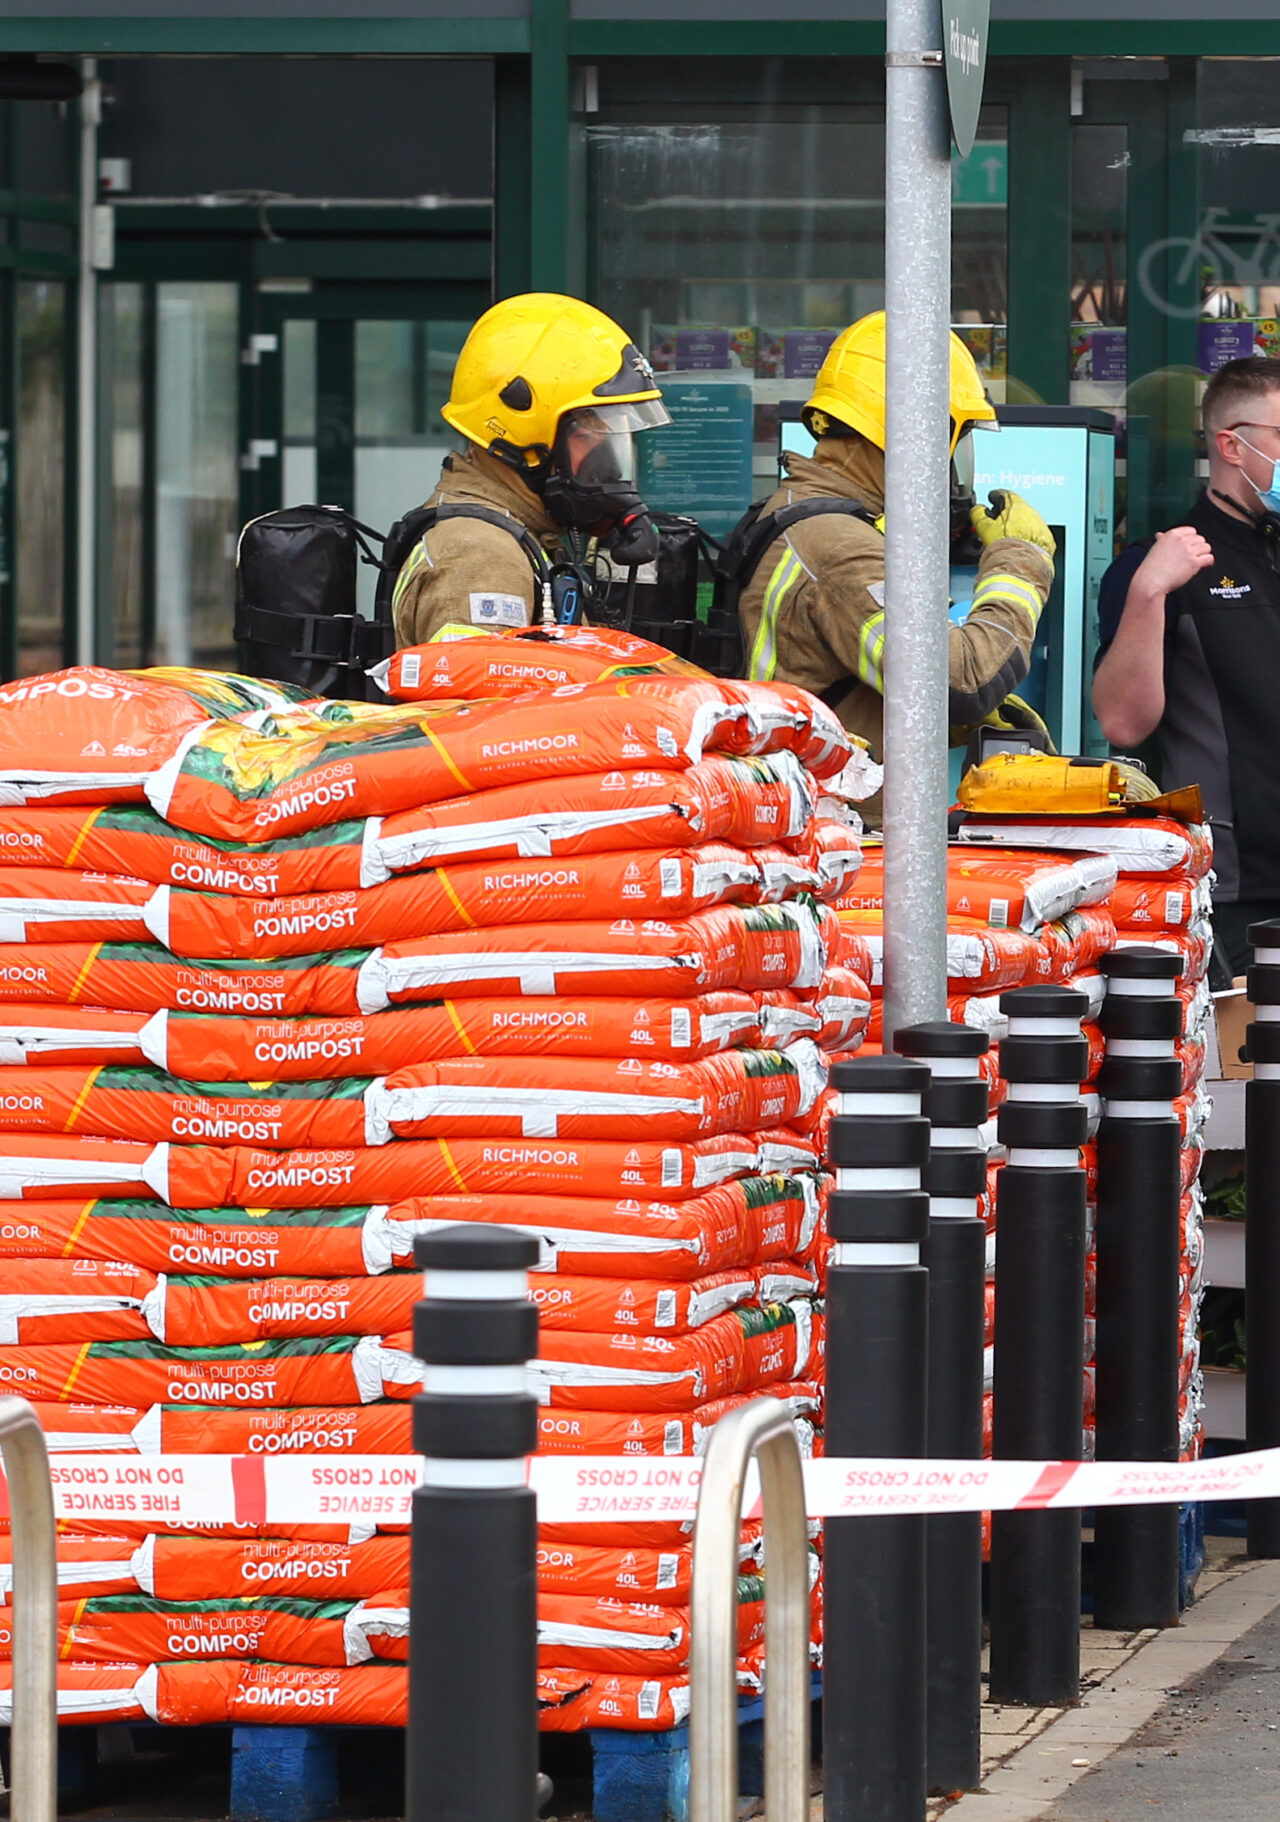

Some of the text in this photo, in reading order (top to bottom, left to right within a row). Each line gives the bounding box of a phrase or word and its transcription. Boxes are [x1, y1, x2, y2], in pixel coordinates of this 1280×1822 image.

[1000, 470, 1065, 489] Hygiene
[432, 674, 452, 684] 40L
[488, 663, 568, 683] RICHMOOR
[482, 734, 579, 758] RICHMOOR
[622, 743, 646, 754] 40L
[254, 778, 358, 827] COMPOST
[172, 844, 279, 872] multi-purpose
[170, 862, 280, 894] COMPOST
[484, 870, 580, 890] RICHMOOR
[621, 884, 642, 895] 40L
[253, 890, 357, 915] multi-purpose
[836, 897, 883, 909] RICHM
[253, 907, 359, 938] COMPOST
[176, 969, 285, 992] multi-purpose
[175, 988, 286, 1011] COMPOST
[492, 1011, 588, 1027] RICHMOOR
[256, 1018, 364, 1041] multi-purpose
[629, 1030, 653, 1041] 40L
[254, 1037, 366, 1062] COMPOST
[172, 1097, 283, 1119] multi-purpose
[171, 1117, 283, 1140] COMPOST
[482, 1147, 579, 1166] RICHMOOR
[247, 1165, 356, 1189] COMPOST
[621, 1170, 645, 1181] 40L
[169, 1224, 279, 1246] multi-purpose
[169, 1243, 280, 1268] COMPOST
[248, 1281, 350, 1301] multi-purpose
[248, 1300, 351, 1323] COMPOST
[614, 1310, 638, 1321] 40L
[167, 1361, 276, 1382] multi-purpose
[167, 1381, 277, 1401] COMPOST
[249, 1411, 358, 1431] multi-purpose
[248, 1428, 358, 1453] COMPOST
[623, 1441, 646, 1451] 40L
[50, 1467, 184, 1485] DO NOT CROSS
[311, 1468, 417, 1487] NOT CROSS
[576, 1470, 638, 1486] CROSS
[646, 1470, 684, 1486] NOT
[844, 1470, 988, 1487] DO NOT CROSS
[63, 1493, 181, 1512] FIRE SERVICE
[318, 1495, 394, 1513] SERVICE
[576, 1496, 699, 1512] FIRE SERVICE
[840, 1493, 916, 1507] SERVICE
[242, 1540, 351, 1559] multi-purpose
[241, 1559, 352, 1581] COMPOST
[616, 1573, 639, 1585] 40L
[166, 1614, 268, 1635] multi-purpose
[599, 1700, 621, 1712] 40L
